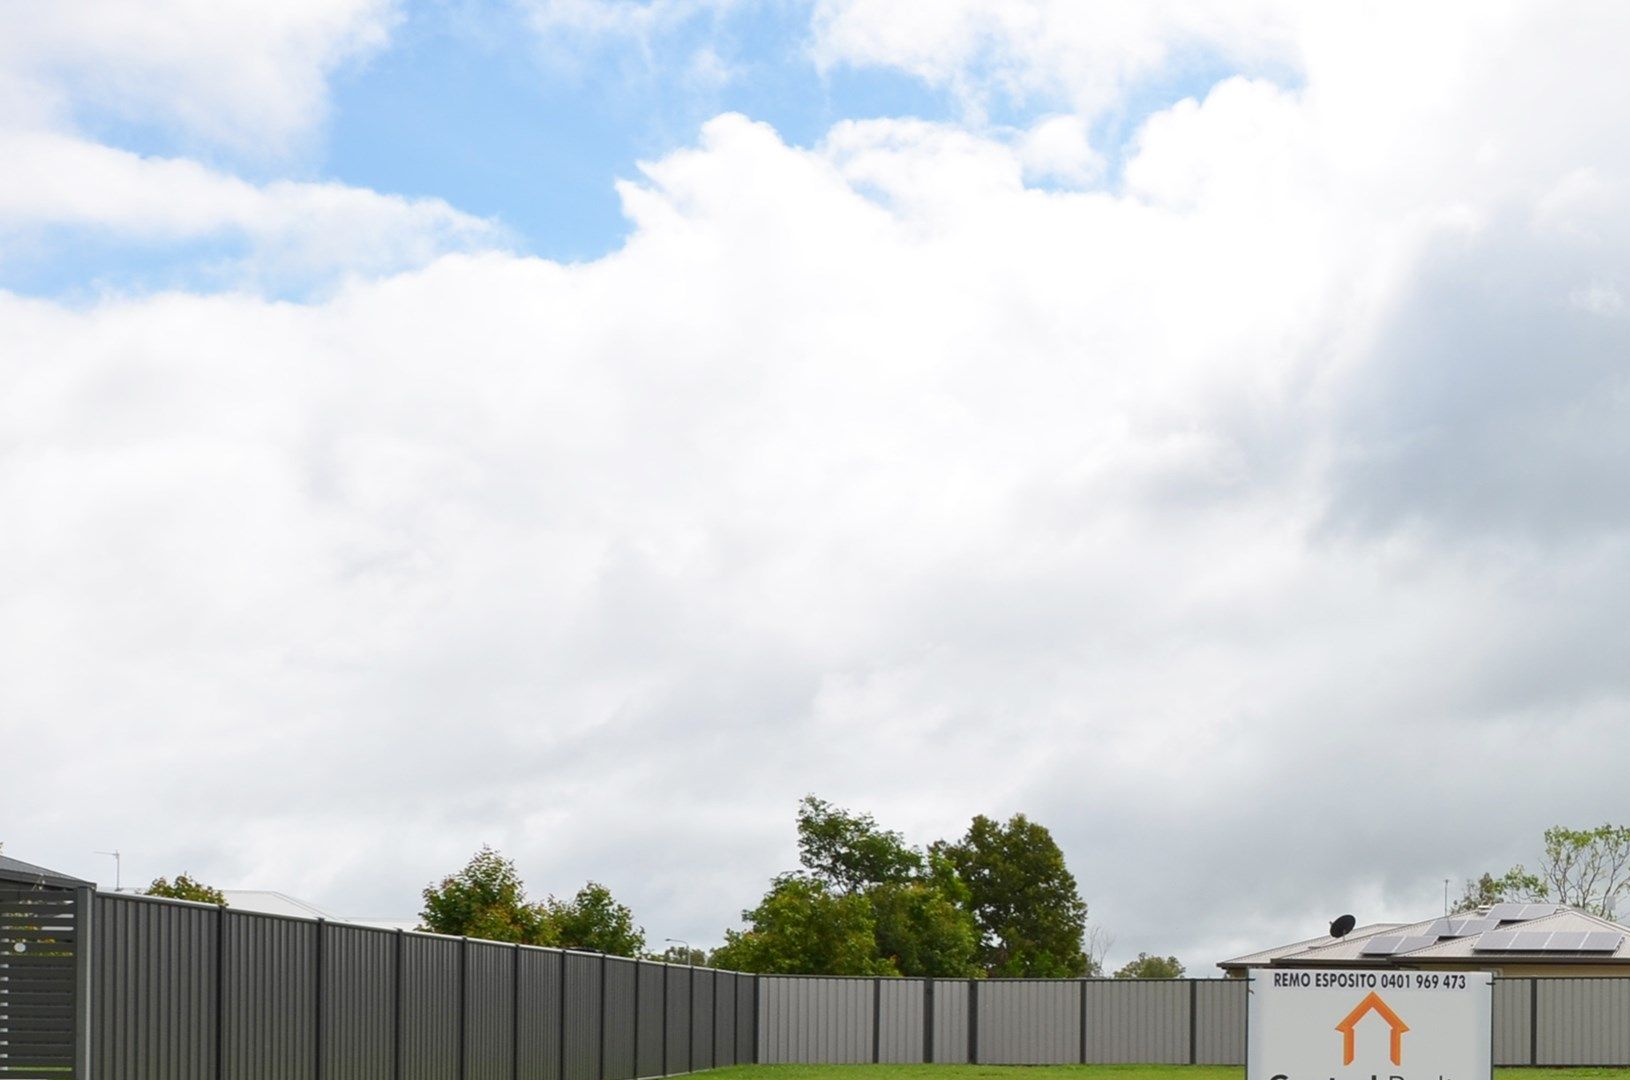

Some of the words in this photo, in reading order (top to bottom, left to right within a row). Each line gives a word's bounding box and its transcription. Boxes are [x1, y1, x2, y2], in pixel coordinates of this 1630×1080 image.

[1274, 973, 1311, 987] REMO
[1315, 973, 1377, 988] ESPOSITO
[1381, 974, 1410, 988] 0401
[1416, 975, 1438, 989] 969
[1443, 975, 1466, 989] 473
